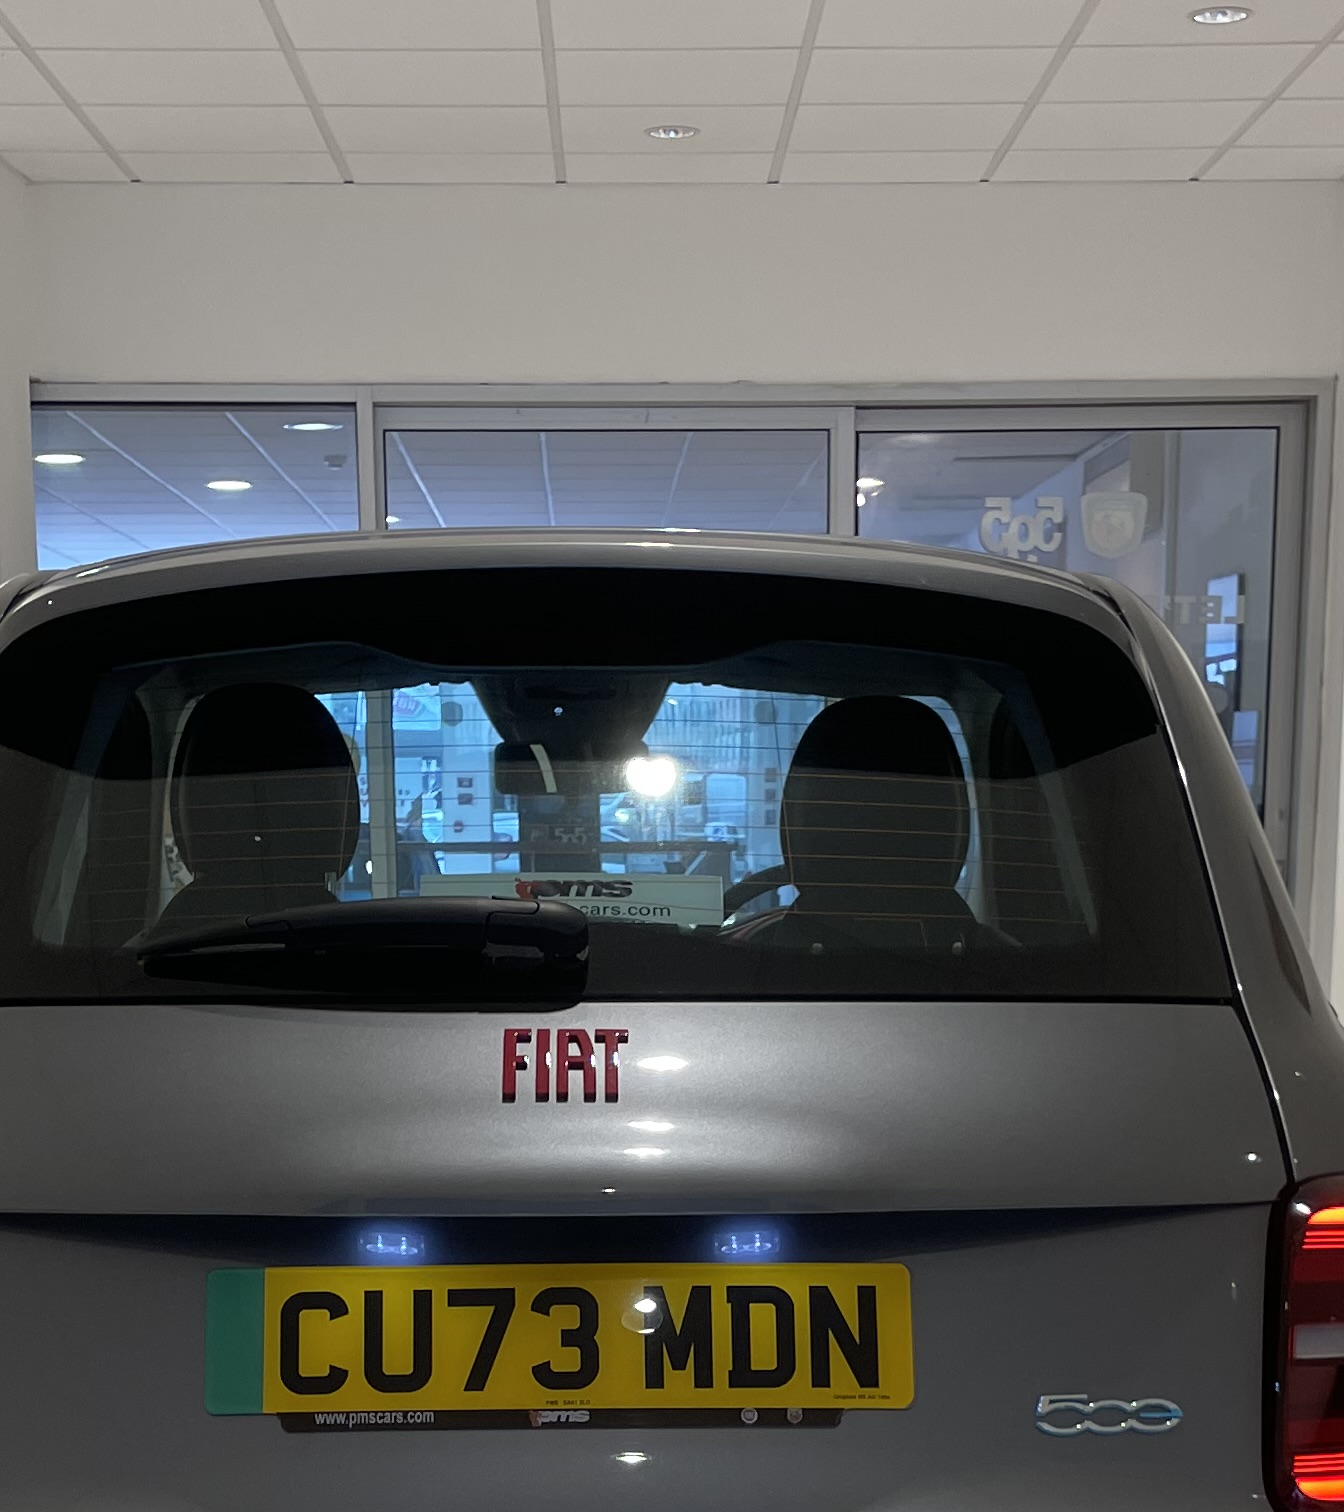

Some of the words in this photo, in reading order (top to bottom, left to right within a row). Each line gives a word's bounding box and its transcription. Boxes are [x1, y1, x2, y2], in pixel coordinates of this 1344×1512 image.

[502, 1028, 629, 1103] FIAT
[279, 1287, 600, 1395] CU73
[643, 1285, 880, 1389] MDN
[313, 1409, 435, 1428] www.pmscars.com
